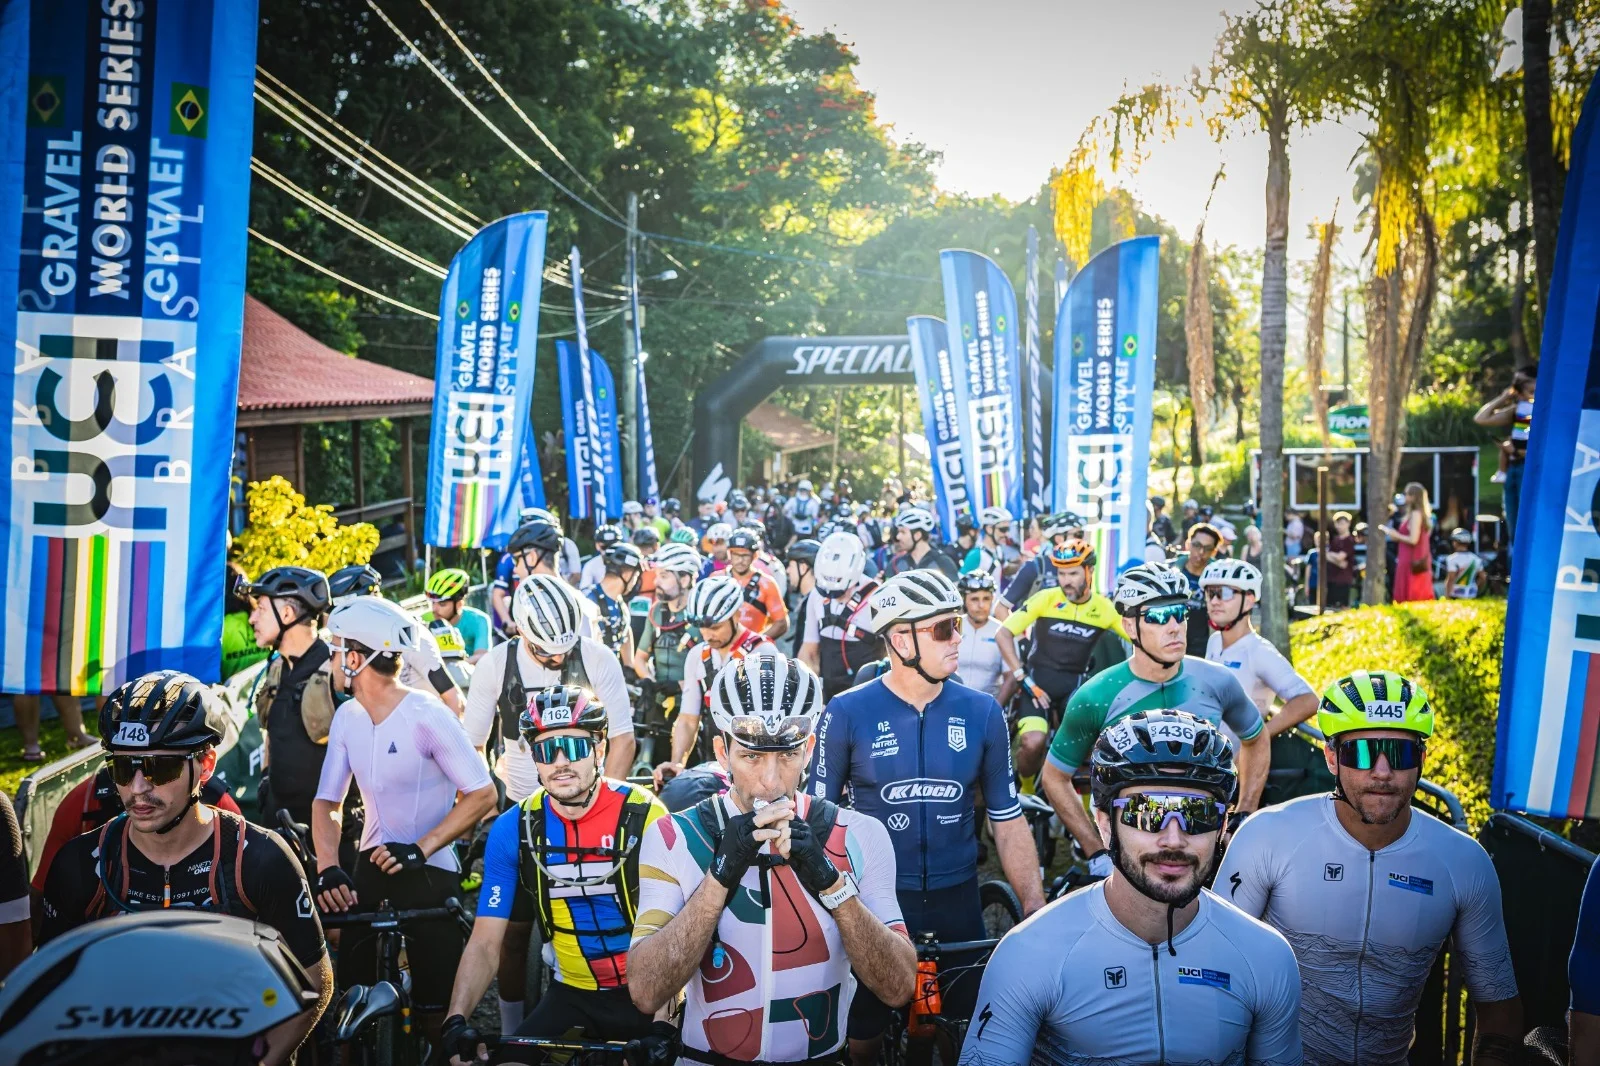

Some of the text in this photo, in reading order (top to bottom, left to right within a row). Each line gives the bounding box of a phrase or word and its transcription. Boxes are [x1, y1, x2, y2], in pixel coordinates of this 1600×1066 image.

[40, 130, 83, 297] GRAVEL
[90, 143, 136, 299] WORLD
[476, 266, 502, 389] WORLD SERIES
[153, 204, 205, 483] BRASIL
[459, 321, 477, 388] GRAVEL
[786, 344, 914, 375] SPECIAL
[967, 338, 983, 396] GRAVEL
[1094, 297, 1115, 429] WORLD SERIES
[1077, 357, 1094, 431] GRAVEL
[33, 334, 118, 526] UCI
[881, 597, 897, 608] 242
[1122, 589, 1136, 598] 322
[548, 708, 570, 721] 162
[1374, 704, 1403, 719] 445
[120, 726, 147, 742] 148
[871, 739, 899, 750] NITRIX
[1158, 725, 1194, 740] 436
[194, 865, 211, 875] ONE
[1183, 967, 1202, 977] UCI
[56, 1005, 250, 1030] S-WORKS
